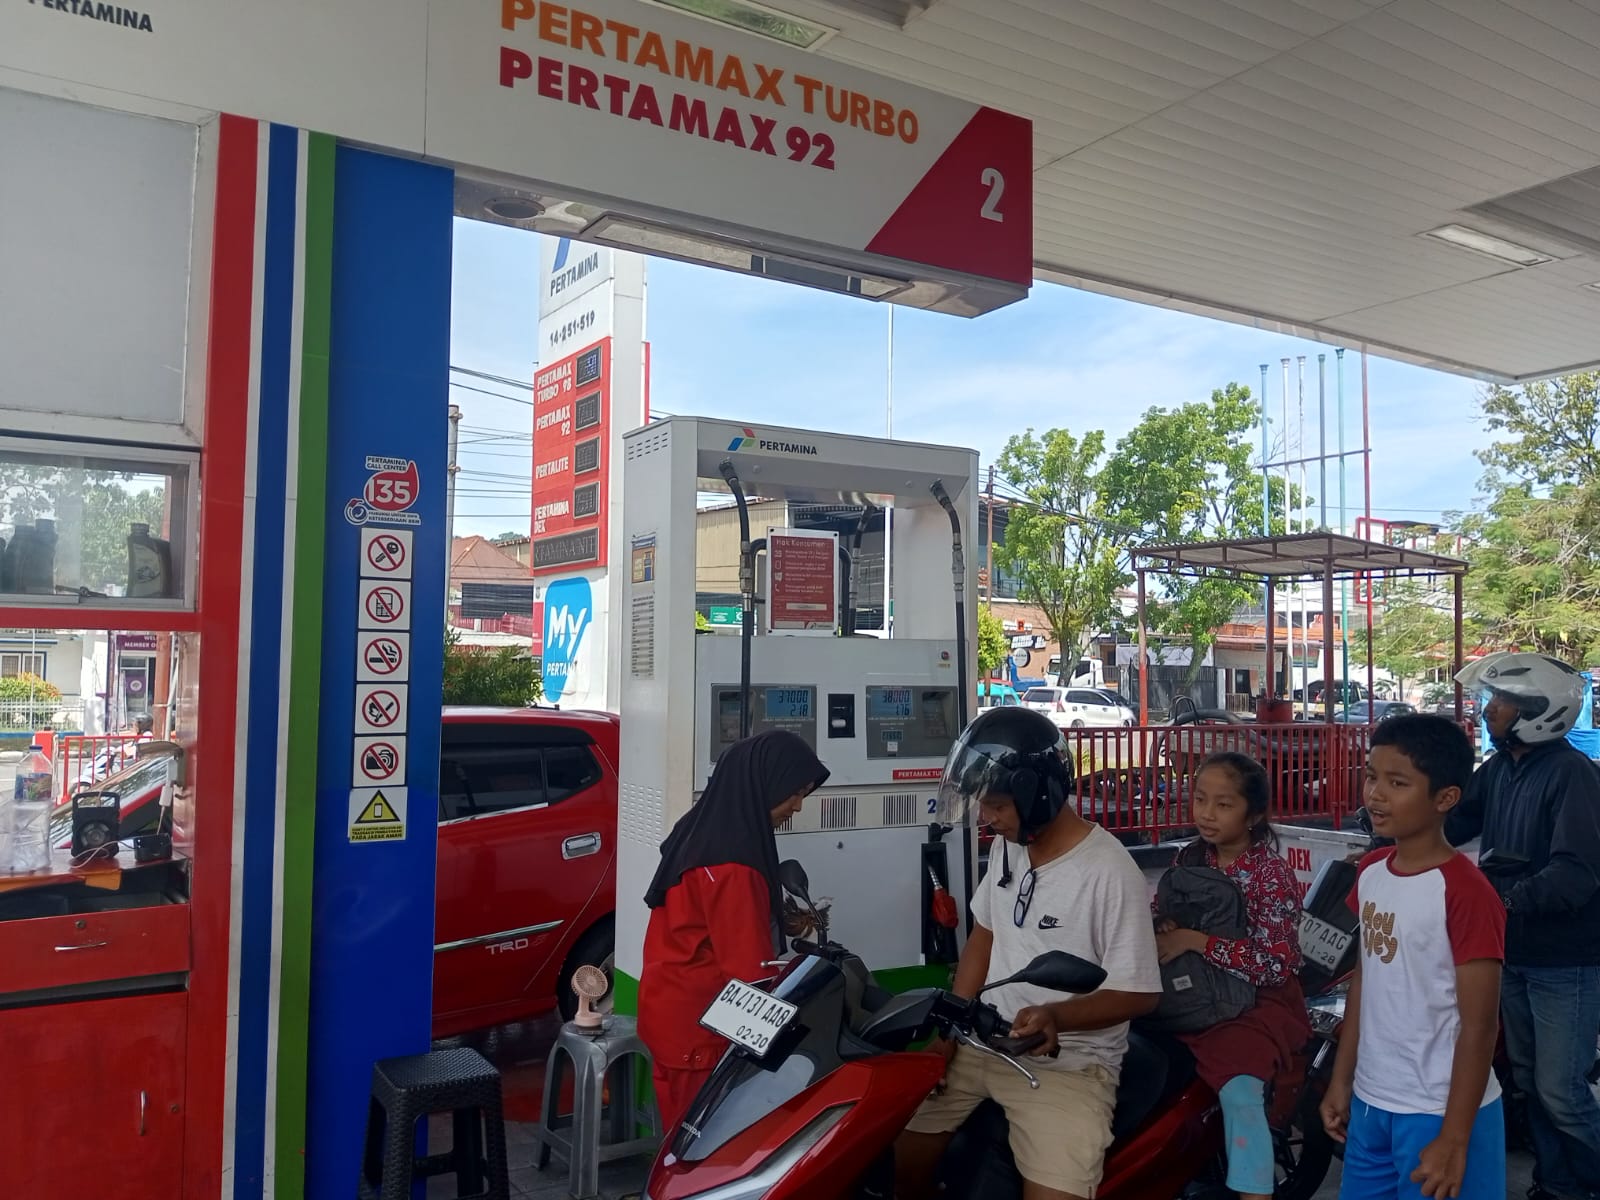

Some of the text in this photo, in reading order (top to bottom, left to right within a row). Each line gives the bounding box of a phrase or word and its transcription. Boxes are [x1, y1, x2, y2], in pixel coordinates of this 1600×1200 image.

[501, 0, 919, 145] PERTAMAX TURBO
[500, 45, 836, 171] PERTAMAX 92
[980, 167, 1006, 223] 2
[550, 251, 599, 296] PERTAMINA
[537, 361, 572, 389] PERTAMAX
[537, 377, 572, 404] TURBO 98
[536, 403, 571, 431] PERTAMAX
[561, 420, 571, 436] 92
[759, 439, 818, 455] PERTAMINA
[367, 456, 407, 466] PERTAMINA
[535, 456, 569, 480] PERTALITE
[368, 479, 411, 504] 135
[534, 500, 569, 521] PERTAMINA
[534, 518, 546, 534] DEX
[898, 770, 931, 778] PERTAMAX
[927, 798, 937, 814] 2
[1287, 847, 1312, 872] DEX
[485, 938, 529, 955] TRD
[720, 983, 742, 1004] BA
[735, 990, 768, 1017] 4131
